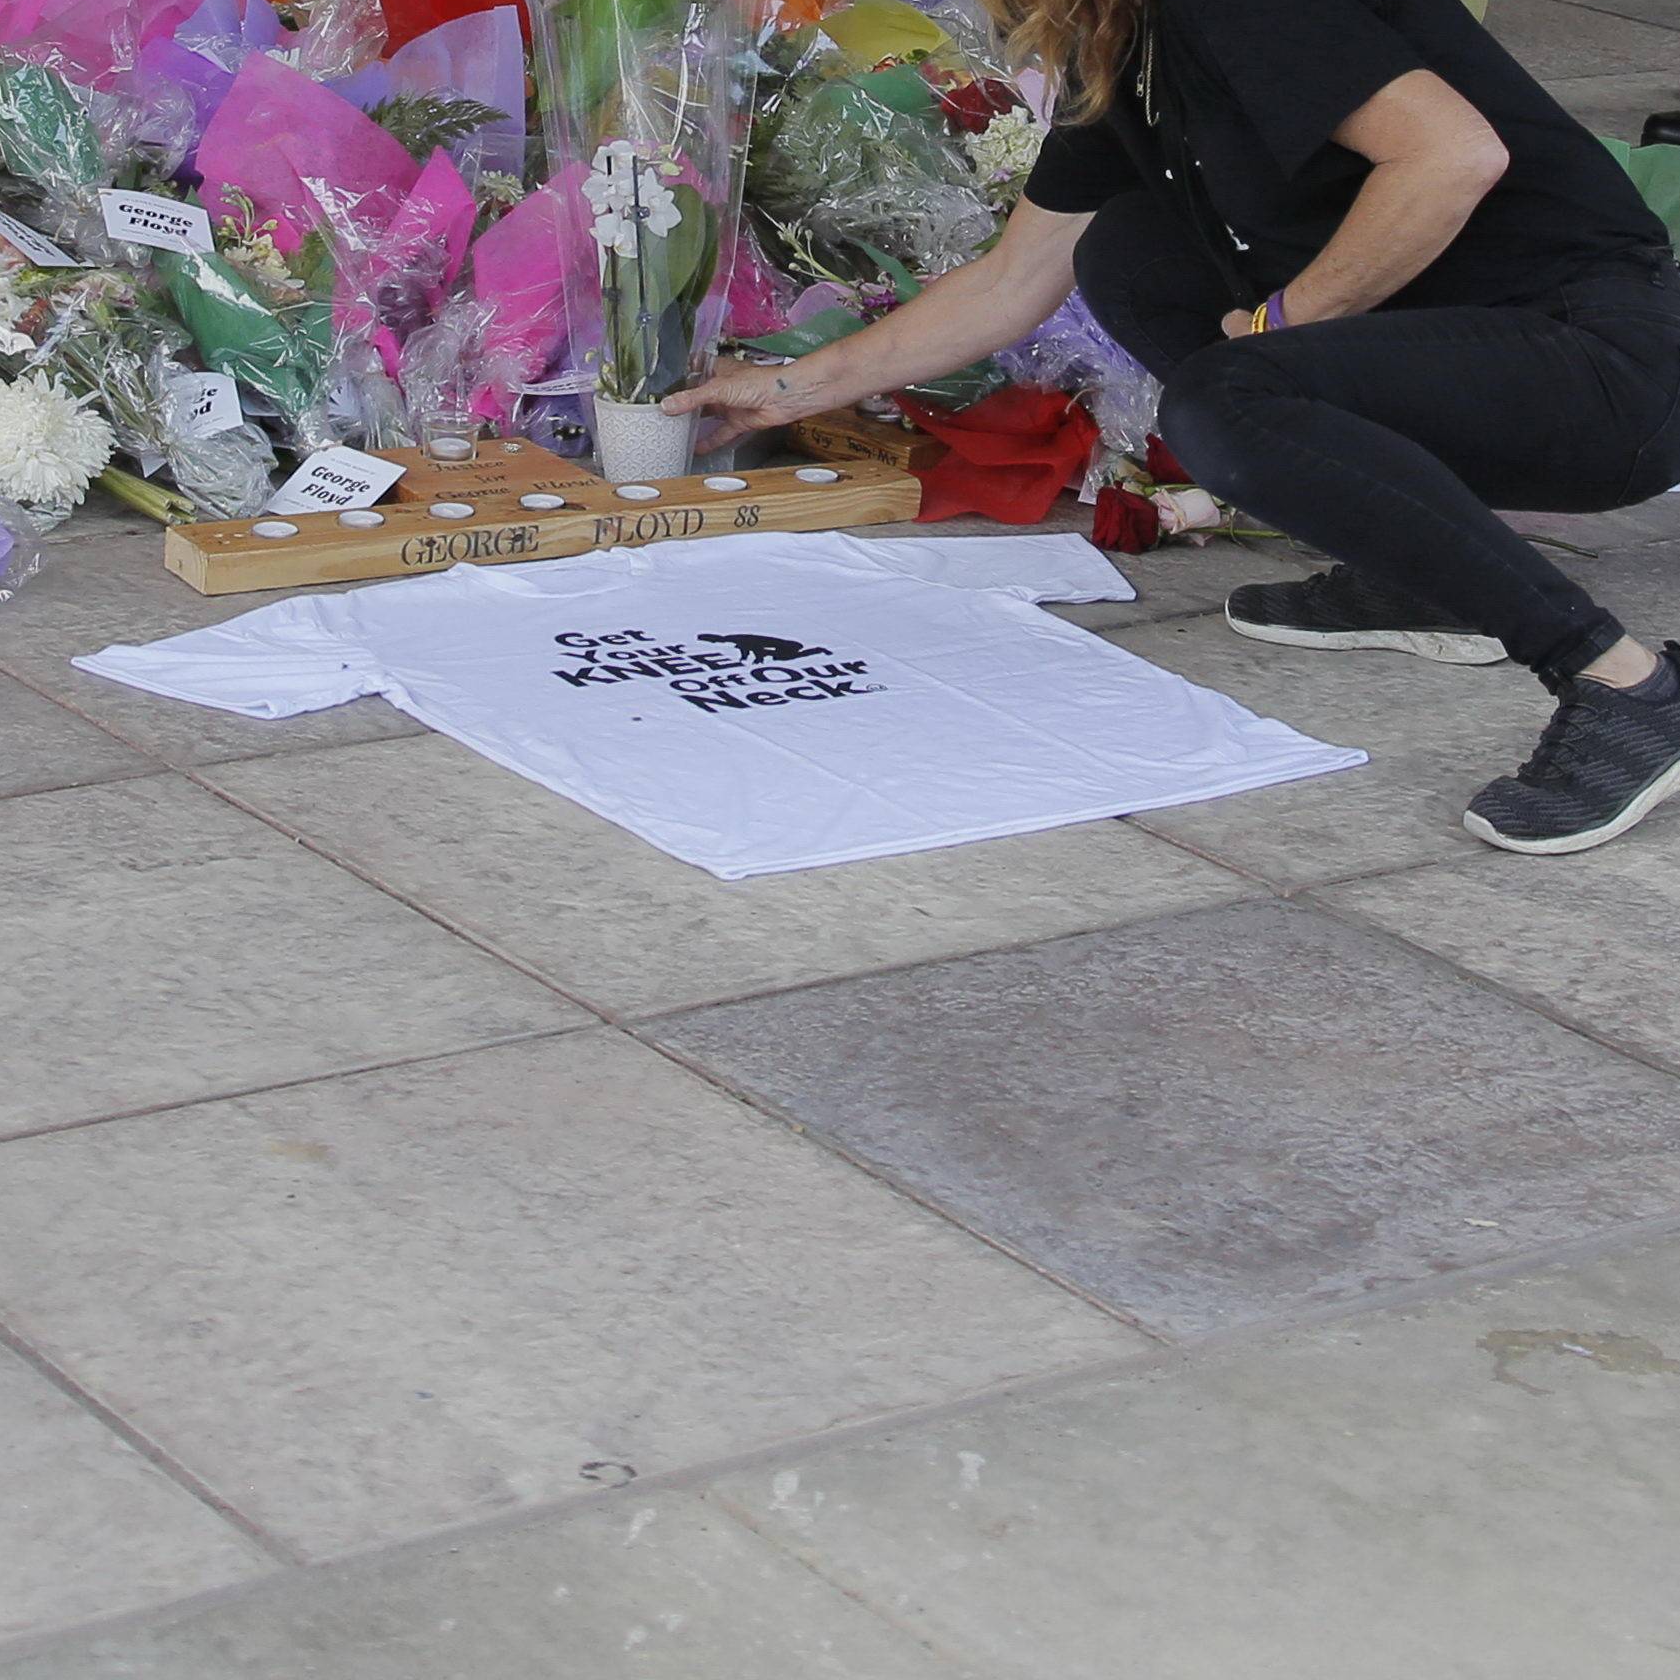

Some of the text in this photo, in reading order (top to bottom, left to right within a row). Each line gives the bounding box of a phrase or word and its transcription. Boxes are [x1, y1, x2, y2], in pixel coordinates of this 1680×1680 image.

[119, 203, 194, 228] George
[129, 217, 188, 237] Floyd
[427, 460, 507, 473] Justice
[310, 465, 371, 494] George
[434, 478, 599, 500] George Floyd
[475, 474, 508, 484] for
[300, 483, 353, 506] Floyd
[401, 504, 761, 566] GEORGE FLOYD 88
[554, 629, 656, 648] Get
[561, 643, 687, 664] Your
[552, 652, 746, 688] KNEE
[670, 660, 868, 692] Off Our
[681, 679, 869, 713] Neck
